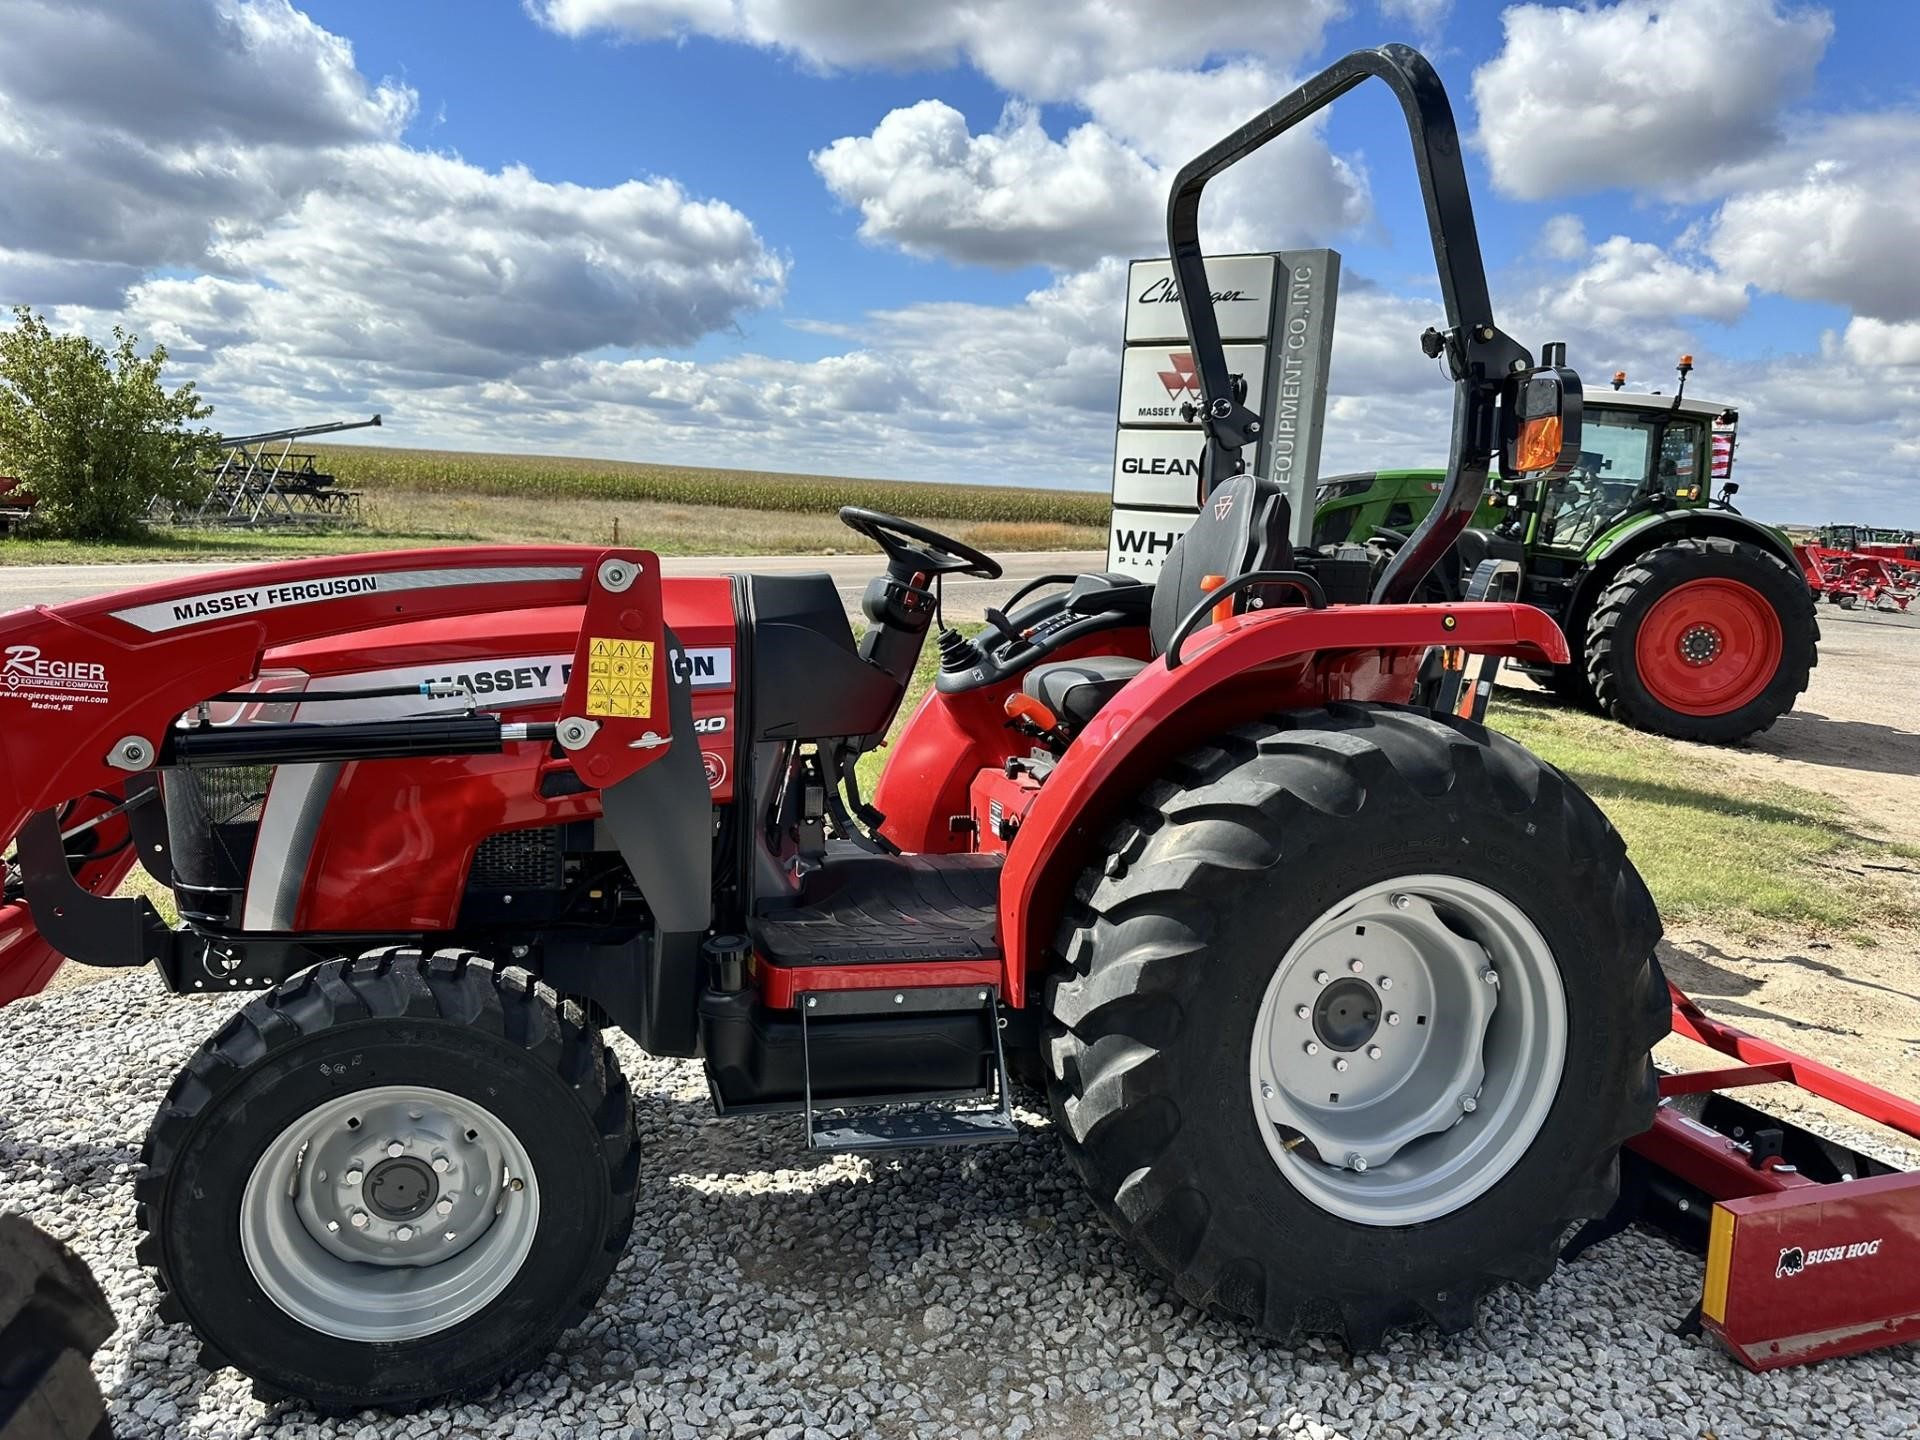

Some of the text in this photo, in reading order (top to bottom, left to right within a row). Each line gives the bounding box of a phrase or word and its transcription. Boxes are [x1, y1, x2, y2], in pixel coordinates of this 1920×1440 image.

[1138, 407, 1176, 417] MASSEY
[1274, 355, 1303, 485] EQUIPMENT
[1122, 457, 1199, 476] GLEAN
[1116, 529, 1184, 556] WH
[173, 576, 378, 621] MASSEY FERGUSON
[3, 645, 105, 680] REGIER
[20, 678, 104, 689] EQUIPMENT COMPANY
[31, 702, 61, 711] Madrid,
[1804, 1240, 1880, 1266] BUSH HOG
